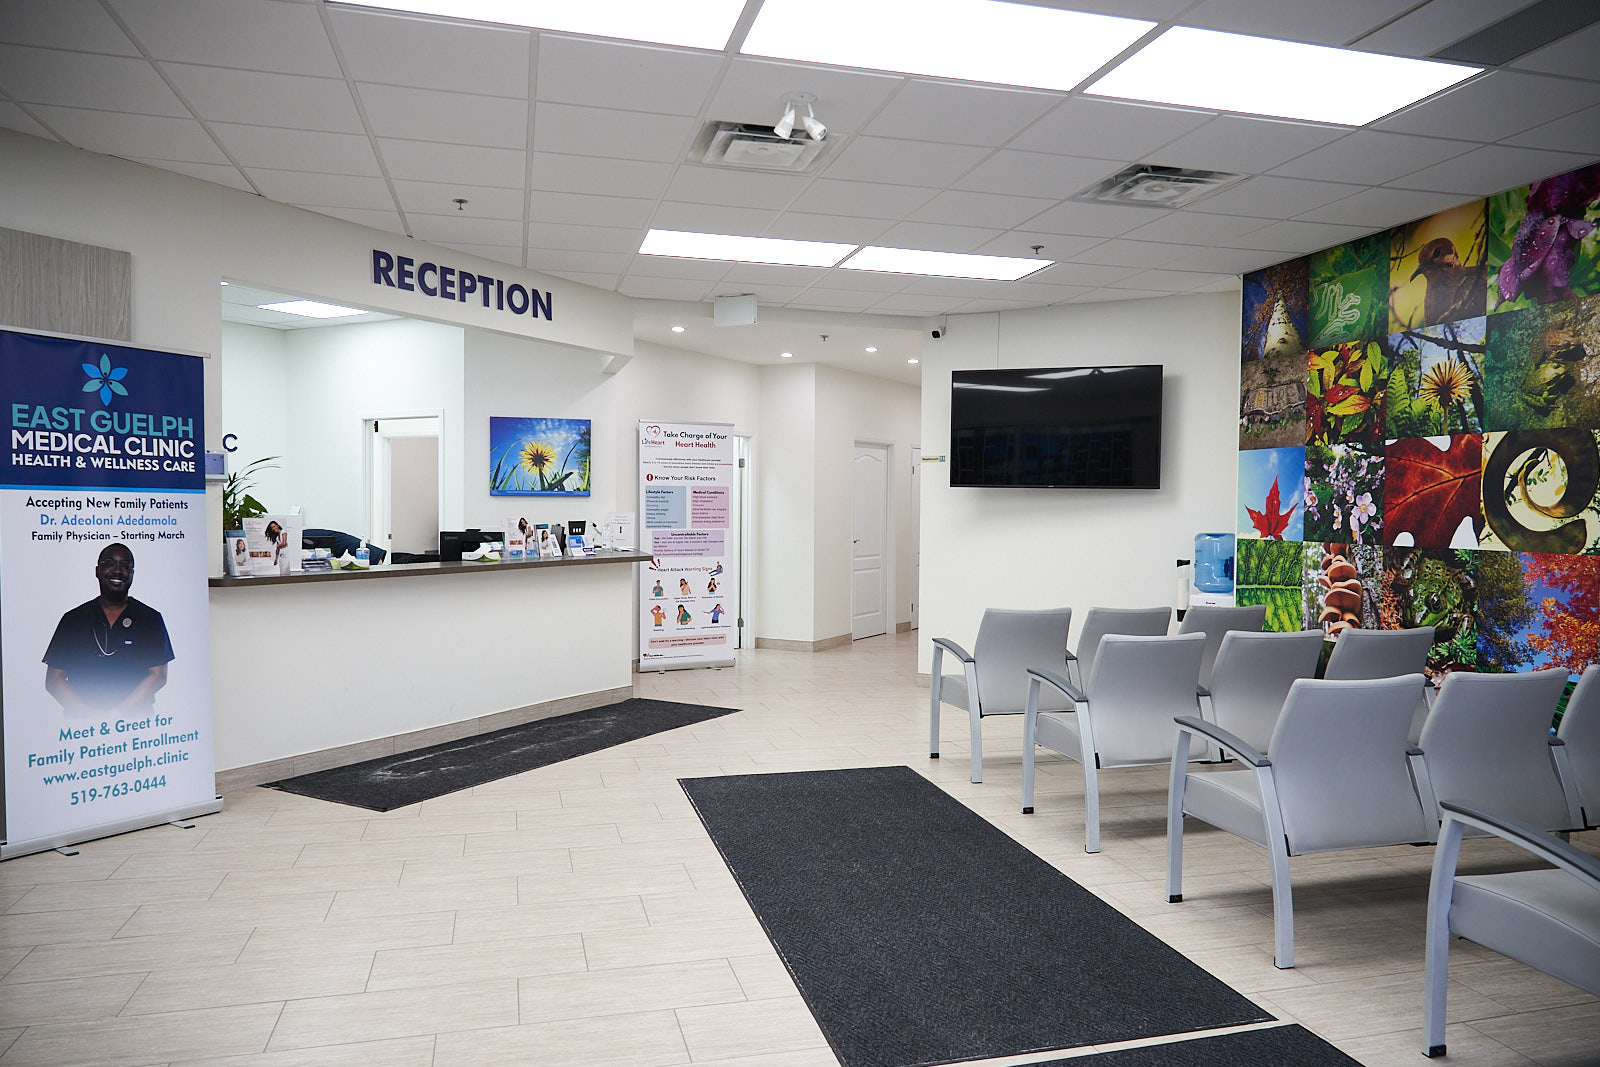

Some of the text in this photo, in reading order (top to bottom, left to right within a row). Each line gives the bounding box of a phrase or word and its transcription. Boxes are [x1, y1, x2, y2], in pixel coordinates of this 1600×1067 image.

[372, 249, 553, 321] RECEPTION
[12, 403, 194, 439] EAST GUELPH
[12, 429, 195, 459] MEDICAL CLINIC
[663, 430, 678, 438] Take
[680, 431, 703, 440] Charge
[712, 432, 727, 440] Your
[695, 441, 716, 449] Health
[12, 453, 196, 472] HEALTH & WELLNESS CARE
[26, 496, 189, 512] Accepting New Family Patients
[40, 513, 177, 526] Dr. Adeoloni Adedamola
[31, 531, 63, 543] Family
[66, 531, 111, 543] Physician
[121, 530, 155, 542] Starting
[157, 530, 185, 540] March
[59, 714, 173, 741] Meet & Greet for
[28, 729, 199, 768] Family Patient Enrollment
[43, 749, 189, 786] www.eastguelph.clinic
[70, 774, 167, 806] 519-763-0444
